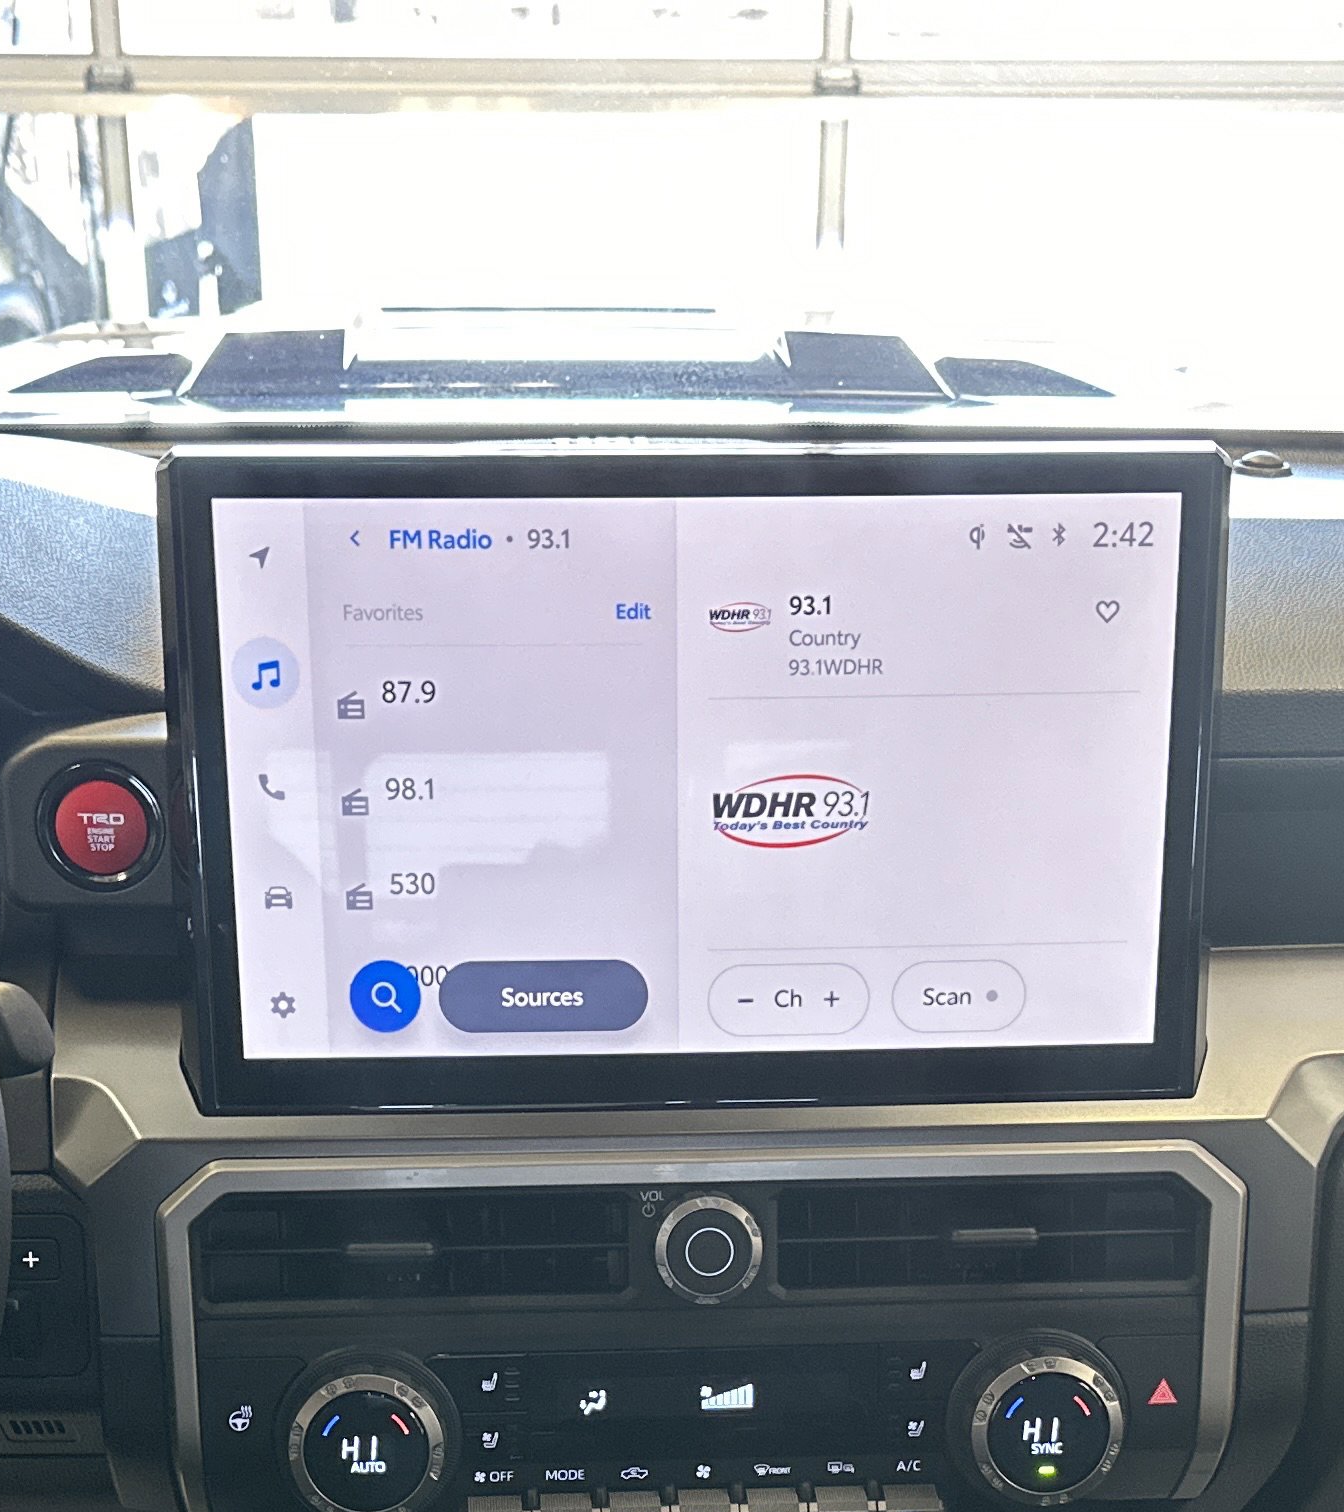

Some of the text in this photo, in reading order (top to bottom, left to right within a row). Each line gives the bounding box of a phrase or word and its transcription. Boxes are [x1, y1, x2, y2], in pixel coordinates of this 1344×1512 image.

[388, 529, 571, 550] FM Radio 93.1
[1092, 521, 1155, 549] 2:42
[342, 603, 424, 622] Favorites
[615, 603, 652, 621] Edit
[708, 608, 751, 621] WDHR
[789, 595, 833, 616] 93.1
[789, 629, 862, 649] Country
[788, 658, 884, 676] 93.1WDHR
[381, 680, 437, 704] 87.9
[385, 778, 436, 801] 98.1
[711, 790, 871, 819] WDHR 93.1
[76, 812, 125, 825] TRD
[712, 818, 869, 833] Today's Best Country
[86, 835, 116, 843] START
[389, 873, 436, 895] 530
[501, 987, 584, 1009] Sources
[774, 988, 803, 1009] Ch
[922, 988, 972, 1007] Scan
[639, 1190, 665, 1202] VOL
[1030, 1442, 1064, 1455] SYNC
[350, 1460, 387, 1474] AUTO
[545, 1468, 585, 1482] MODE
[768, 1464, 791, 1476] FRONT
[896, 1459, 922, 1473] A/C
[489, 1470, 515, 1483] OFF
